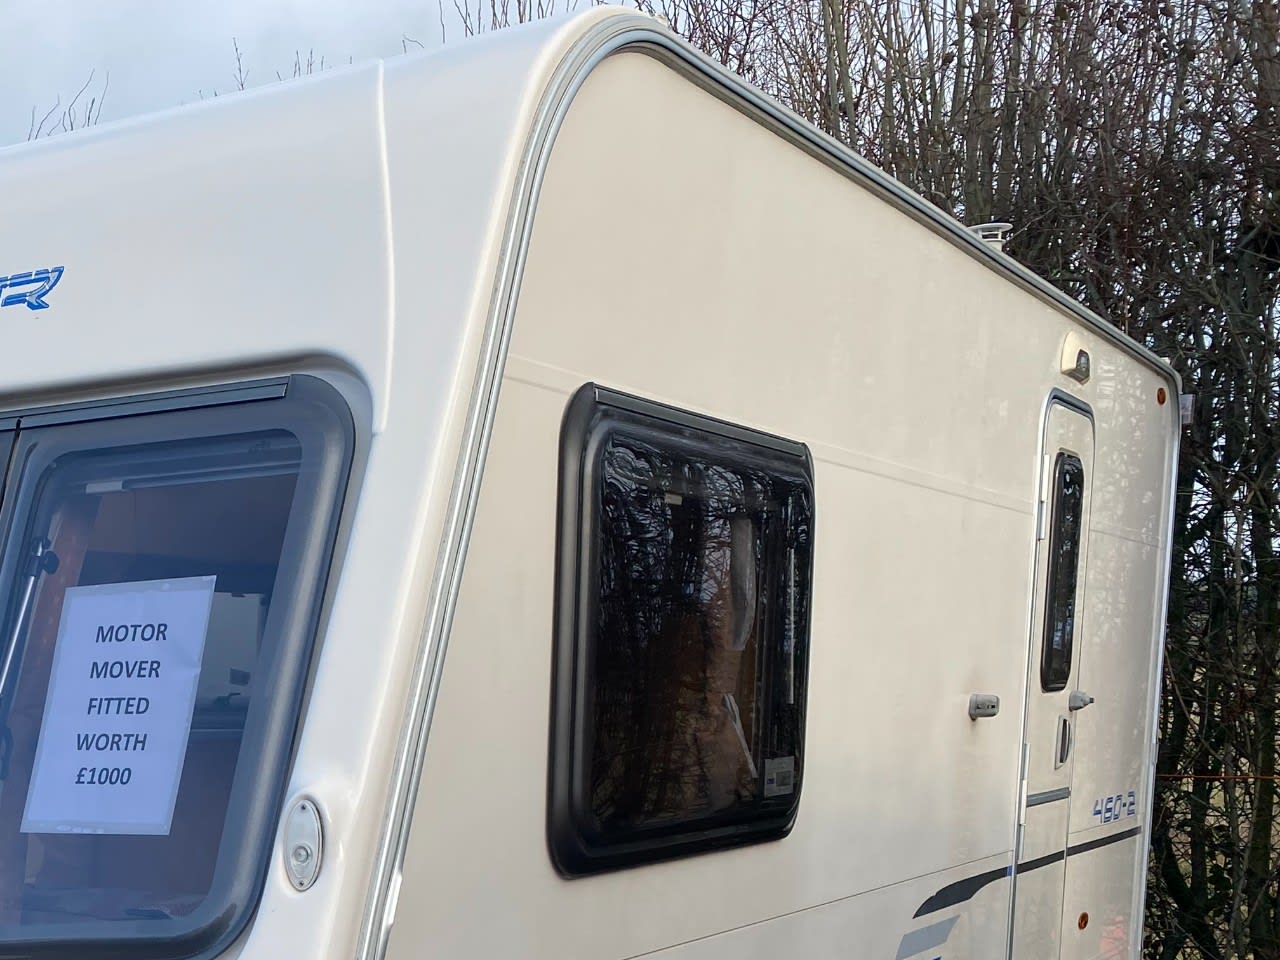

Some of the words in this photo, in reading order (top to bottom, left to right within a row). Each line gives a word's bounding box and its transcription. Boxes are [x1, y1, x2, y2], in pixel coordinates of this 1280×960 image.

[95, 623, 168, 643] MOTOR
[90, 661, 161, 679] MOVER
[87, 697, 150, 715] FITTED
[75, 733, 148, 751] WORTH
[74, 767, 132, 786] £1000
[1092, 791, 1136, 824] 460-2
